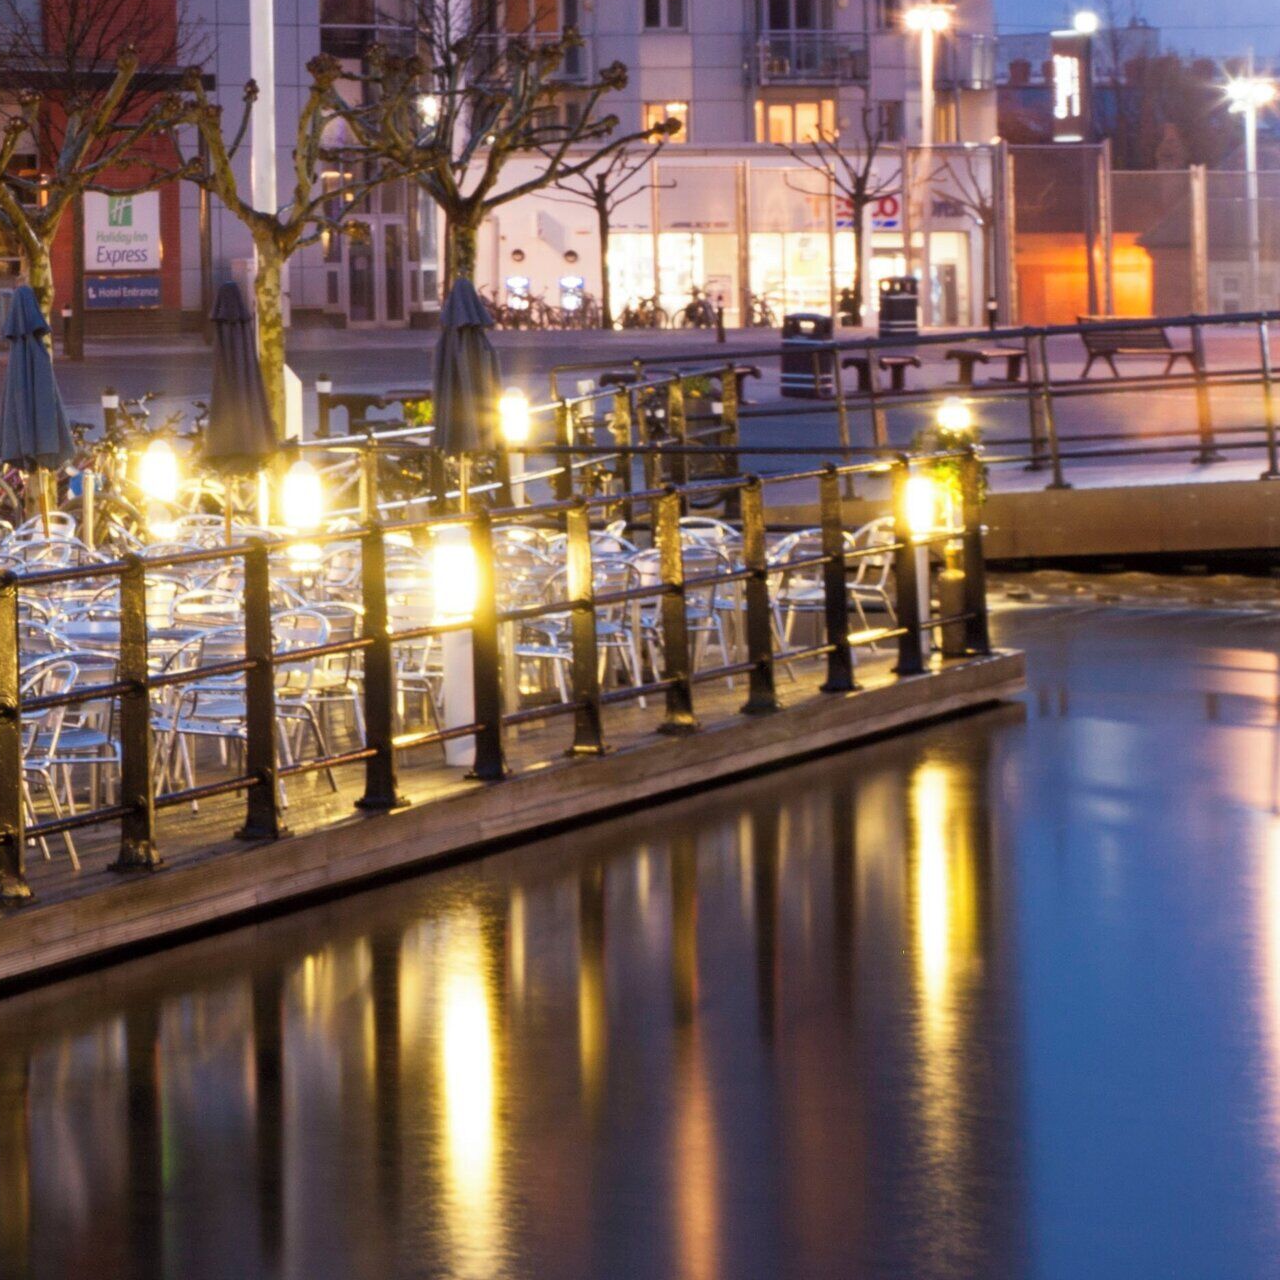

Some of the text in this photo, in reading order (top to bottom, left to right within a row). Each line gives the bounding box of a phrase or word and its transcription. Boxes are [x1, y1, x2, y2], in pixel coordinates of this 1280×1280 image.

[804, 195, 900, 218] TESO
[96, 231, 148, 245] Holiday Inn
[96, 245, 148, 267] Express
[98, 287, 160, 299] Hotel Entrance
